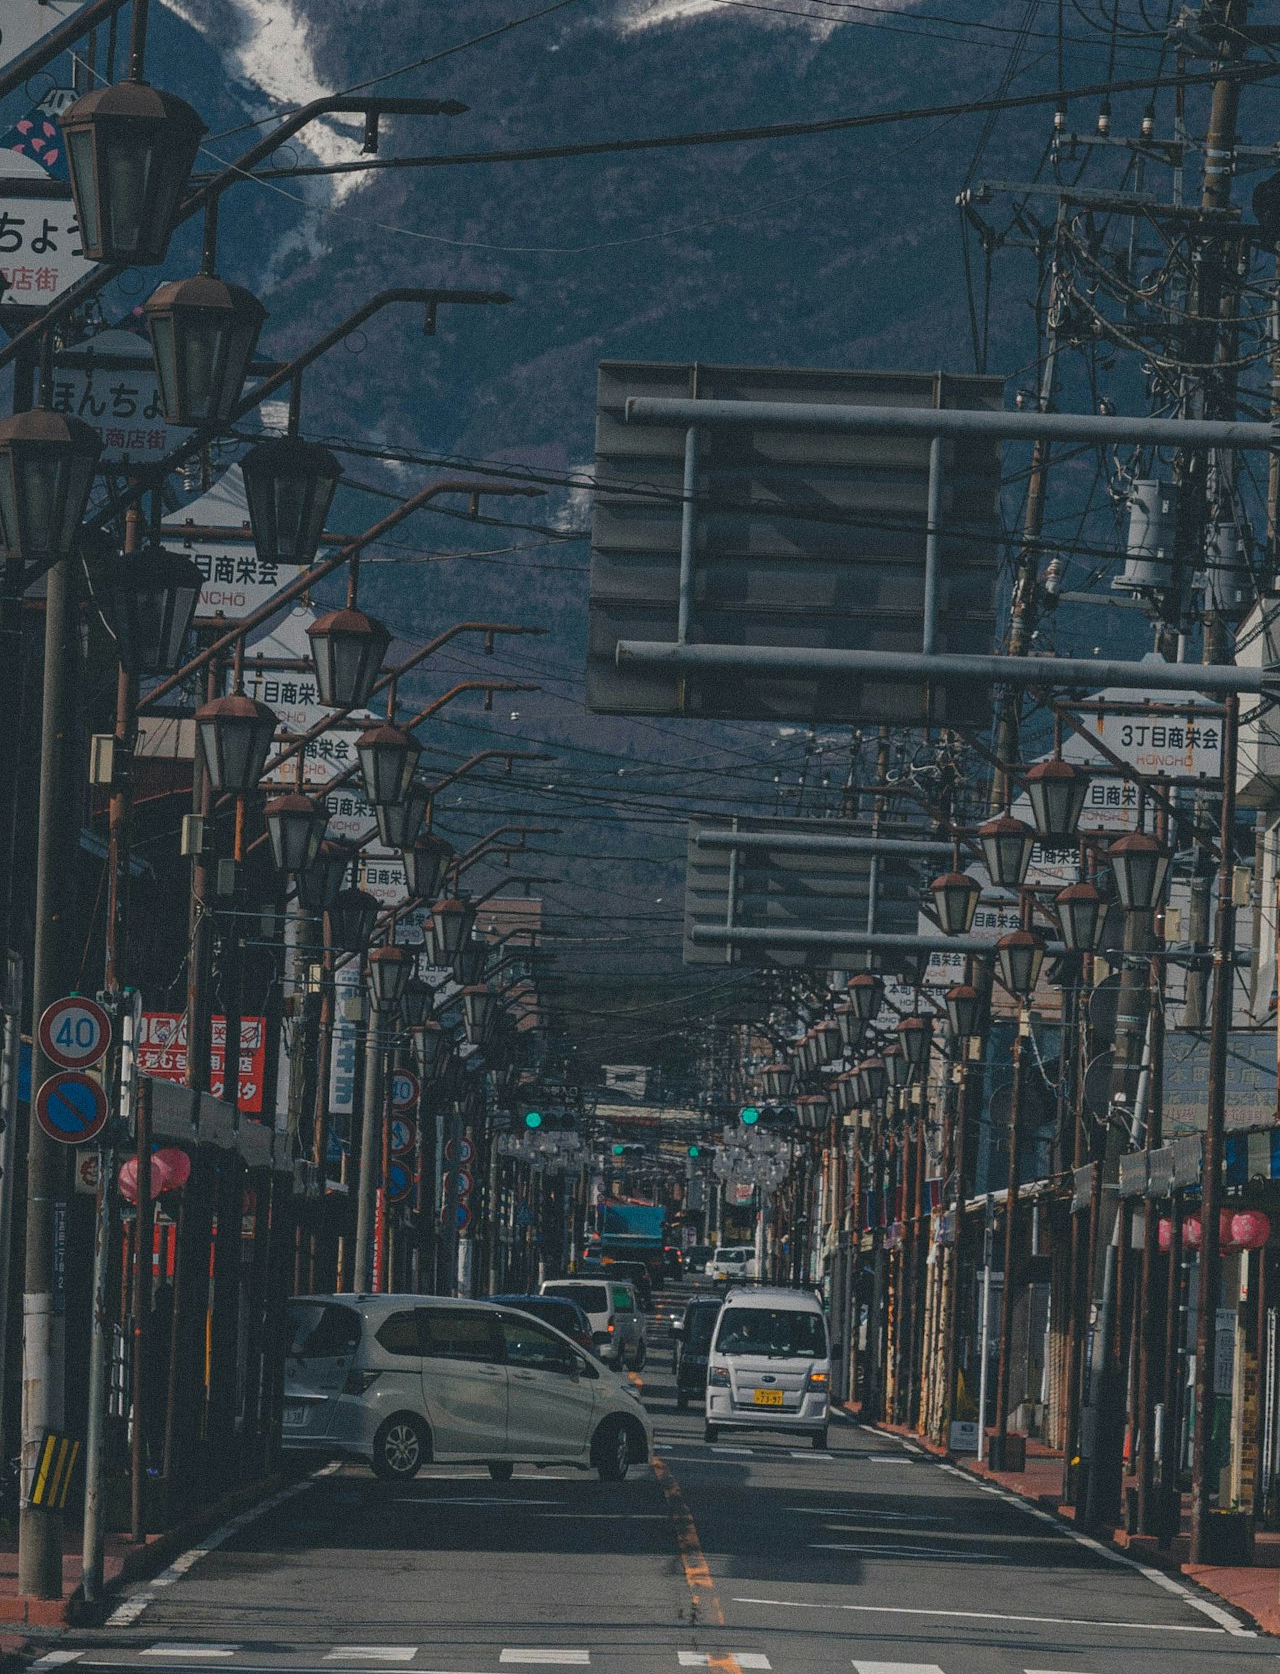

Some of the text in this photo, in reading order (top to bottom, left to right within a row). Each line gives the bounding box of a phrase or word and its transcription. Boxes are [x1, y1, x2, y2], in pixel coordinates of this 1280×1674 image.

[1121, 724, 1219, 750] 3丁目商栄会
[54, 1017, 96, 1048] 40
